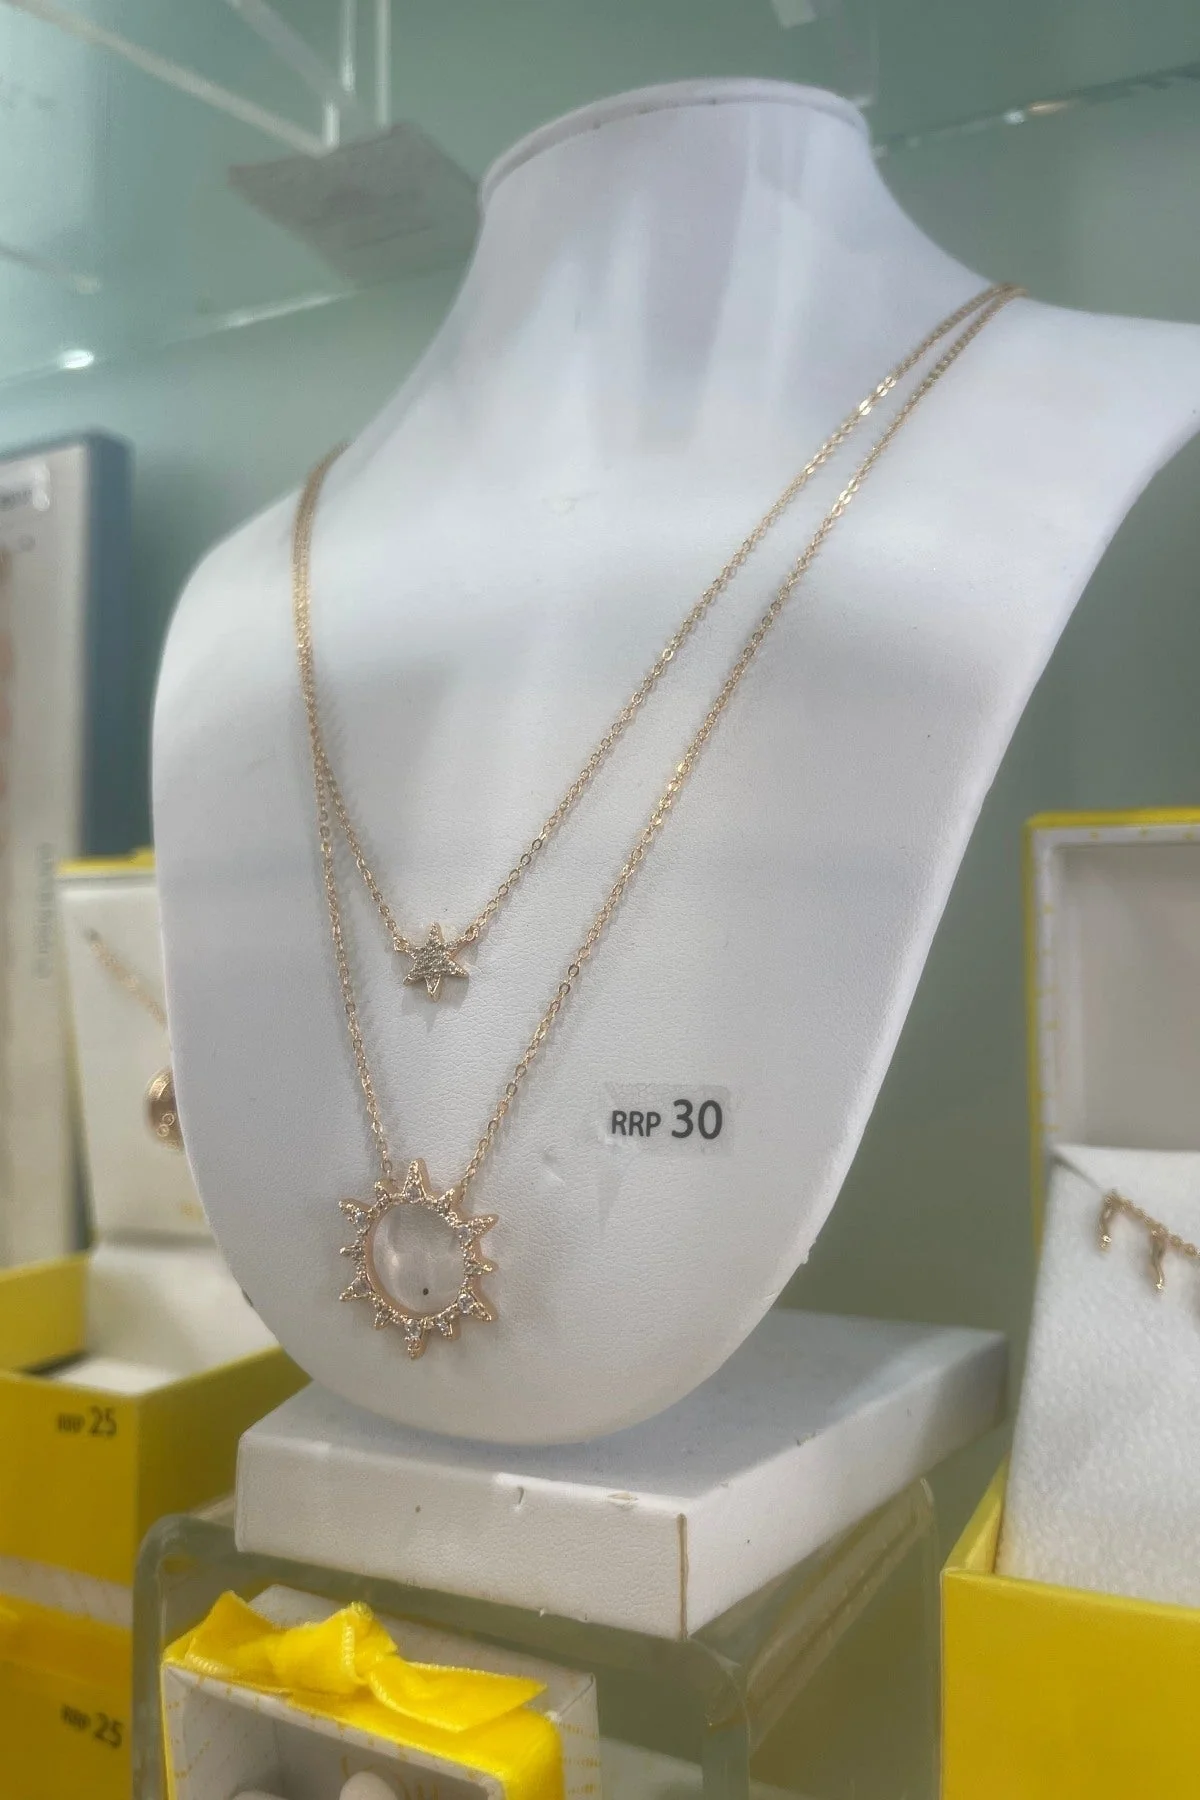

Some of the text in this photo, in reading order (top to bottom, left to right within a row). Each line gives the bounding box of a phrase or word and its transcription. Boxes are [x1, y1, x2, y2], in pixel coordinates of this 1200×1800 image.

[611, 1098, 723, 1140] RRP 30
[88, 1404, 118, 1439] 25
[93, 1711, 123, 1750] 25
